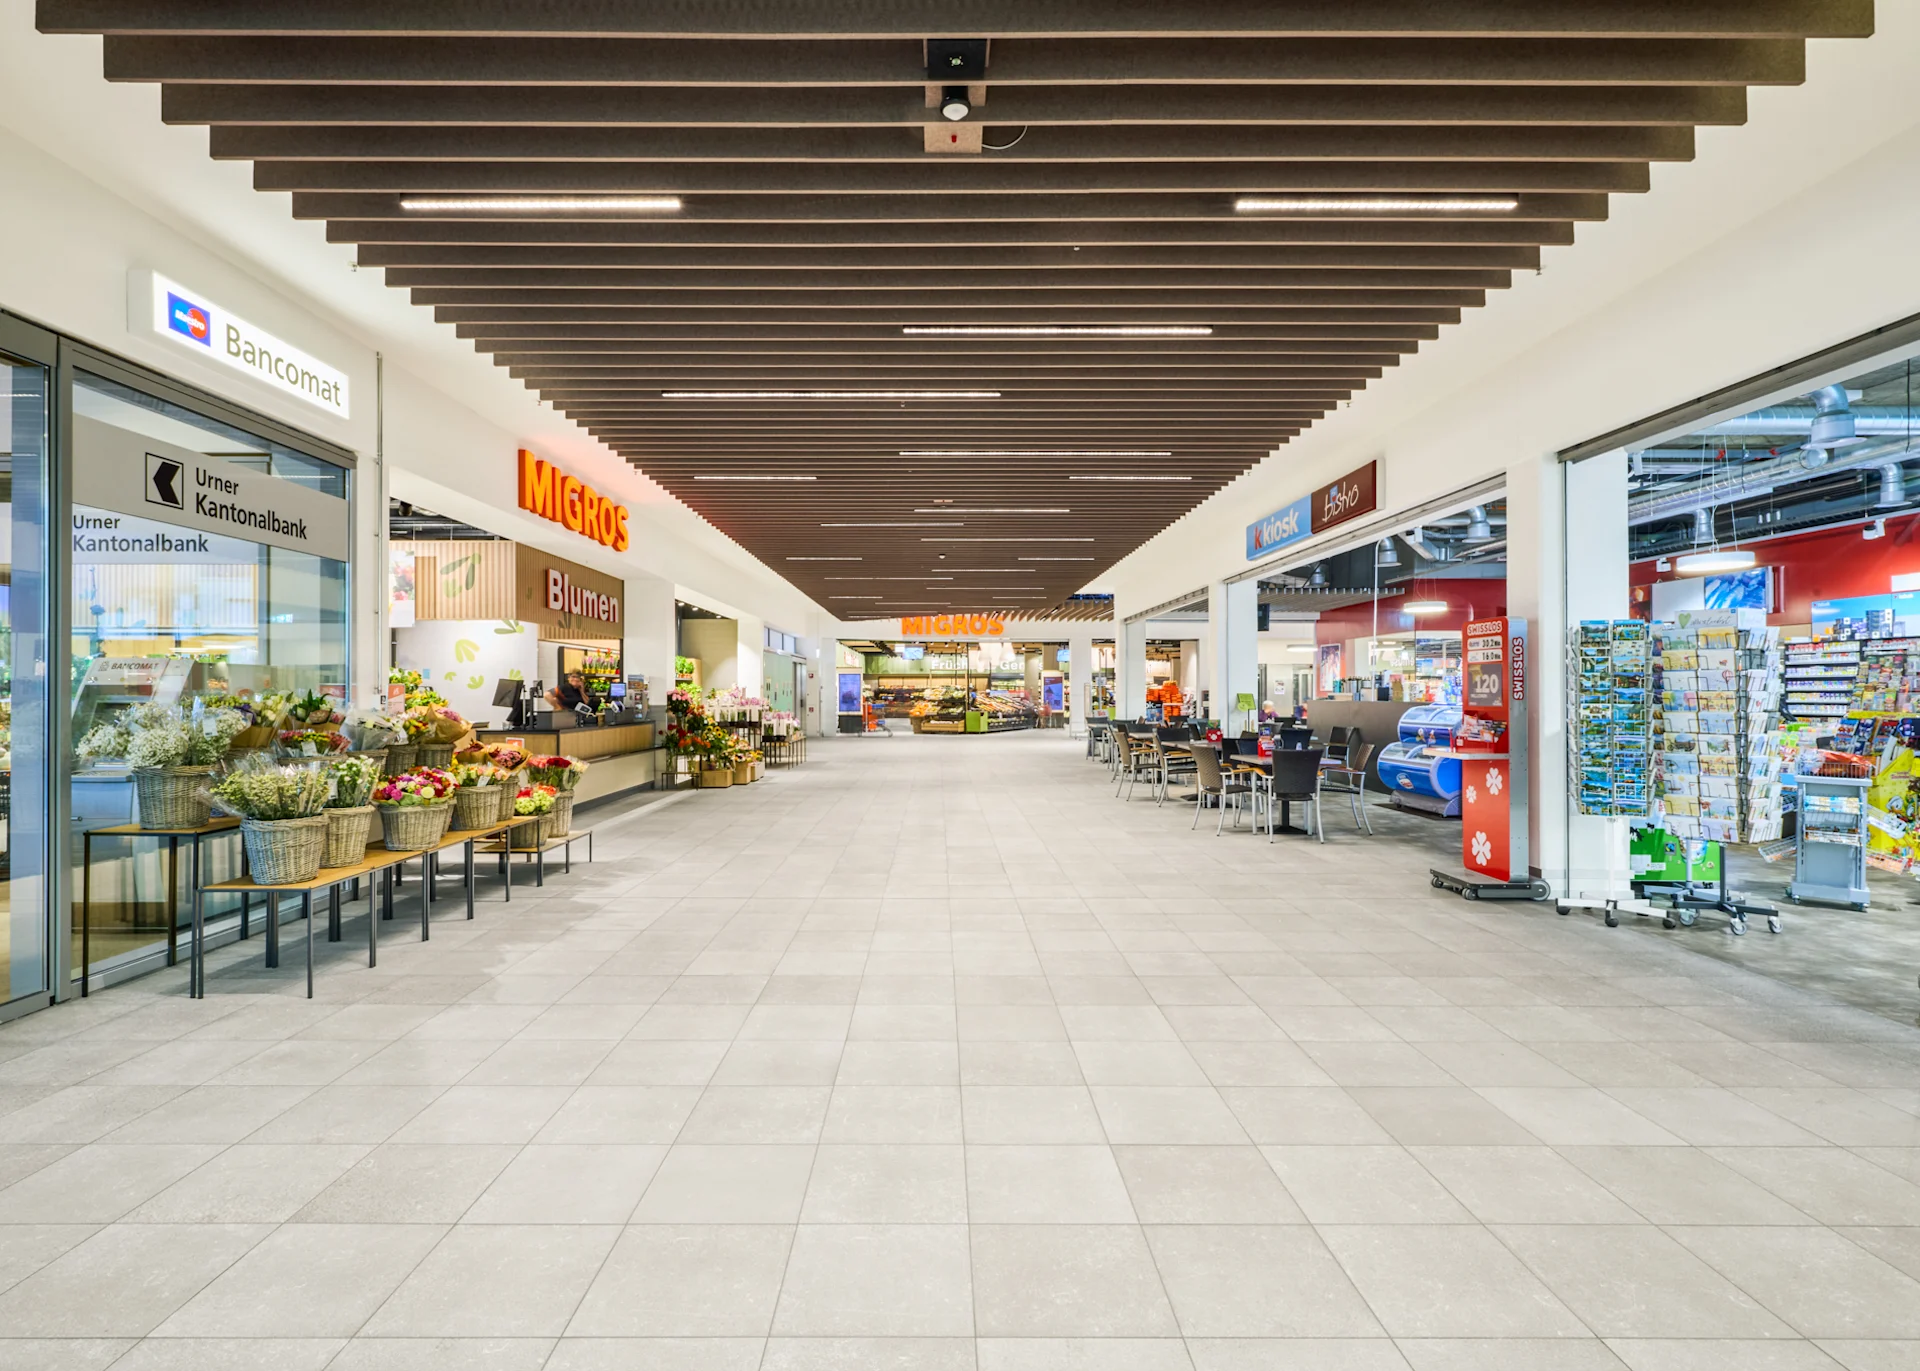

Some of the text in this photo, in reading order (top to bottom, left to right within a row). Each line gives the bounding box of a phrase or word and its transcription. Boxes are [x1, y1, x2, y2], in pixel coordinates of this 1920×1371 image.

[175, 309, 205, 331] Maestro
[226, 323, 341, 407] Bancomat
[195, 467, 239, 496] Urner
[518, 449, 629, 552] MIGROS
[1322, 481, 1359, 522] bistro
[73, 515, 121, 529] Urner
[195, 492, 308, 540] Kantonalbank
[1263, 508, 1299, 546] kiosk
[73, 533, 209, 552] Kantonalbank
[546, 568, 619, 623] Blumen
[901, 614, 1004, 636] MIGROS
[1468, 622, 1502, 634] SWISSLOS
[111, 662, 160, 670] BANCOMAT
[1513, 637, 1524, 700] SWISSLOS
[1475, 674, 1498, 693] 120
